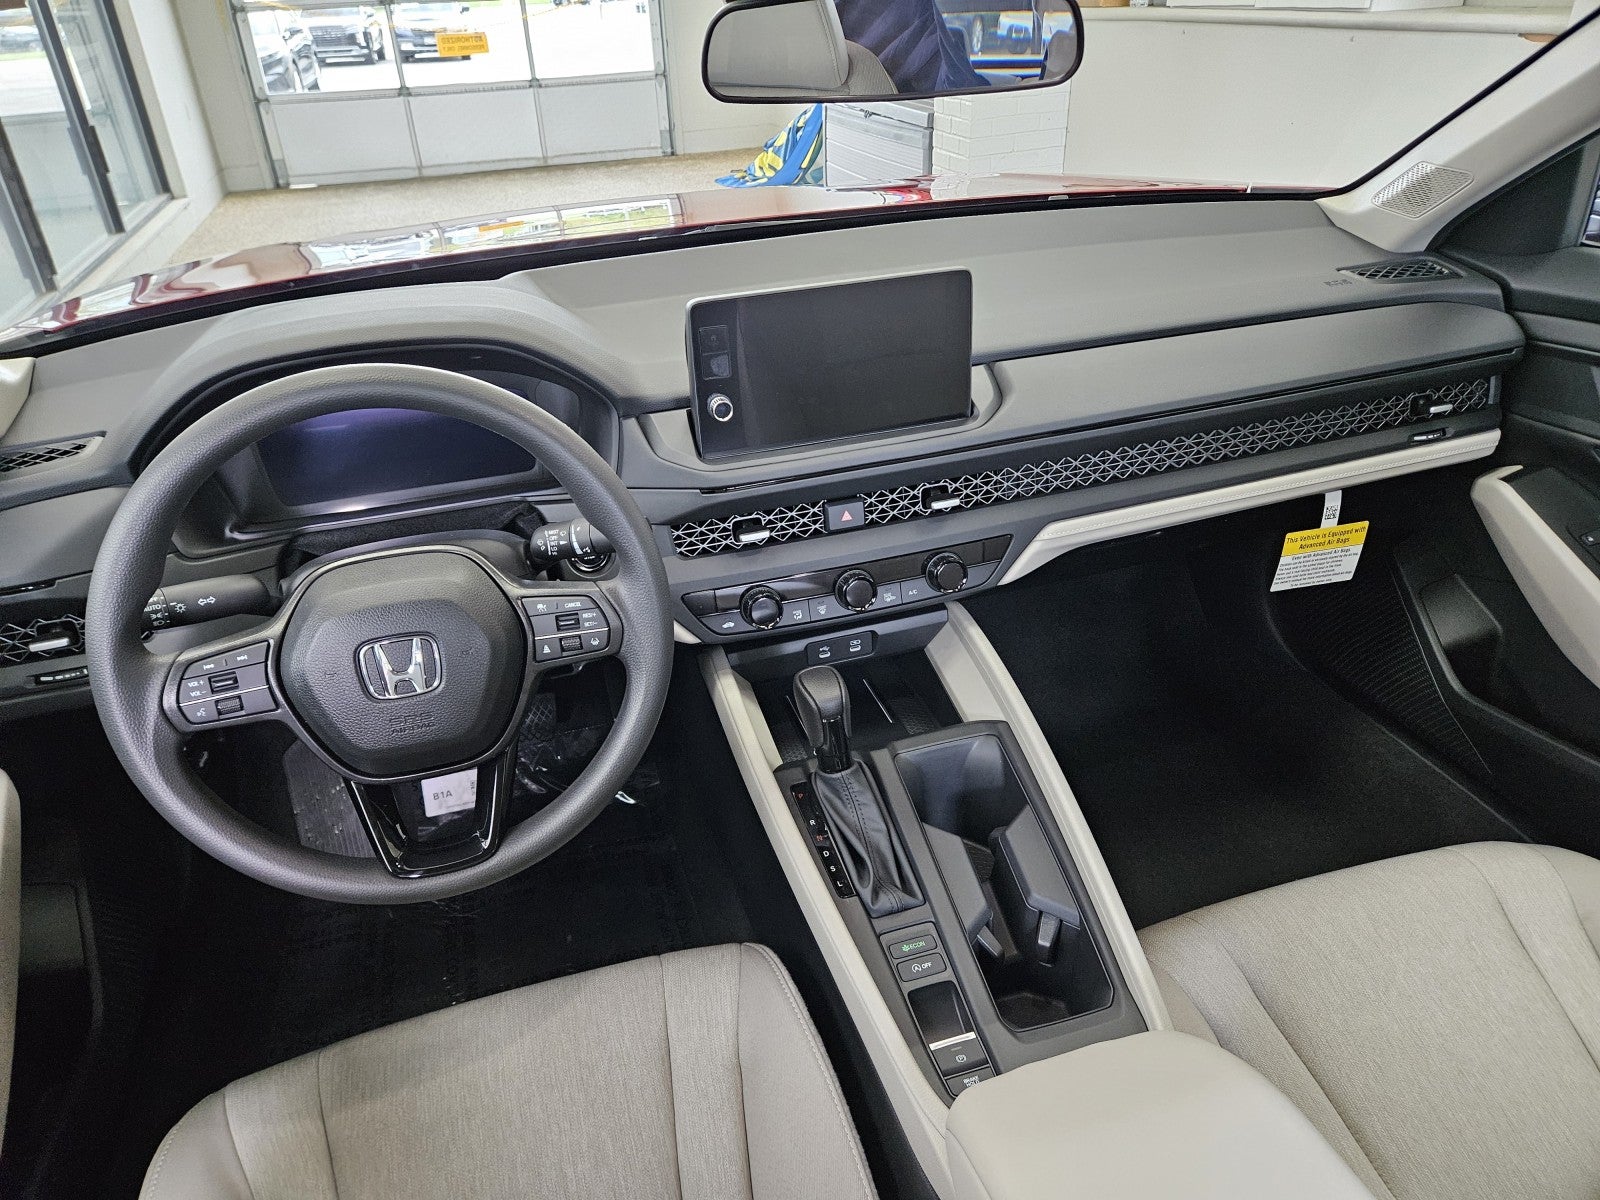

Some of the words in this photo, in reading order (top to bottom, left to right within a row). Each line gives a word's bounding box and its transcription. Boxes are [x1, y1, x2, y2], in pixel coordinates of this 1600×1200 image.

[1300, 534, 1320, 542] Vehicle
[1327, 528, 1354, 538] Equipped
[1299, 541, 1326, 550] Advanced
[1312, 550, 1333, 558] Advanced
[143, 603, 162, 612] AUTO
[187, 680, 200, 688] VOL
[190, 690, 202, 698] VOL
[432, 789, 453, 801] B1A
[909, 940, 926, 950] ECON
[921, 961, 933, 969] OFF
